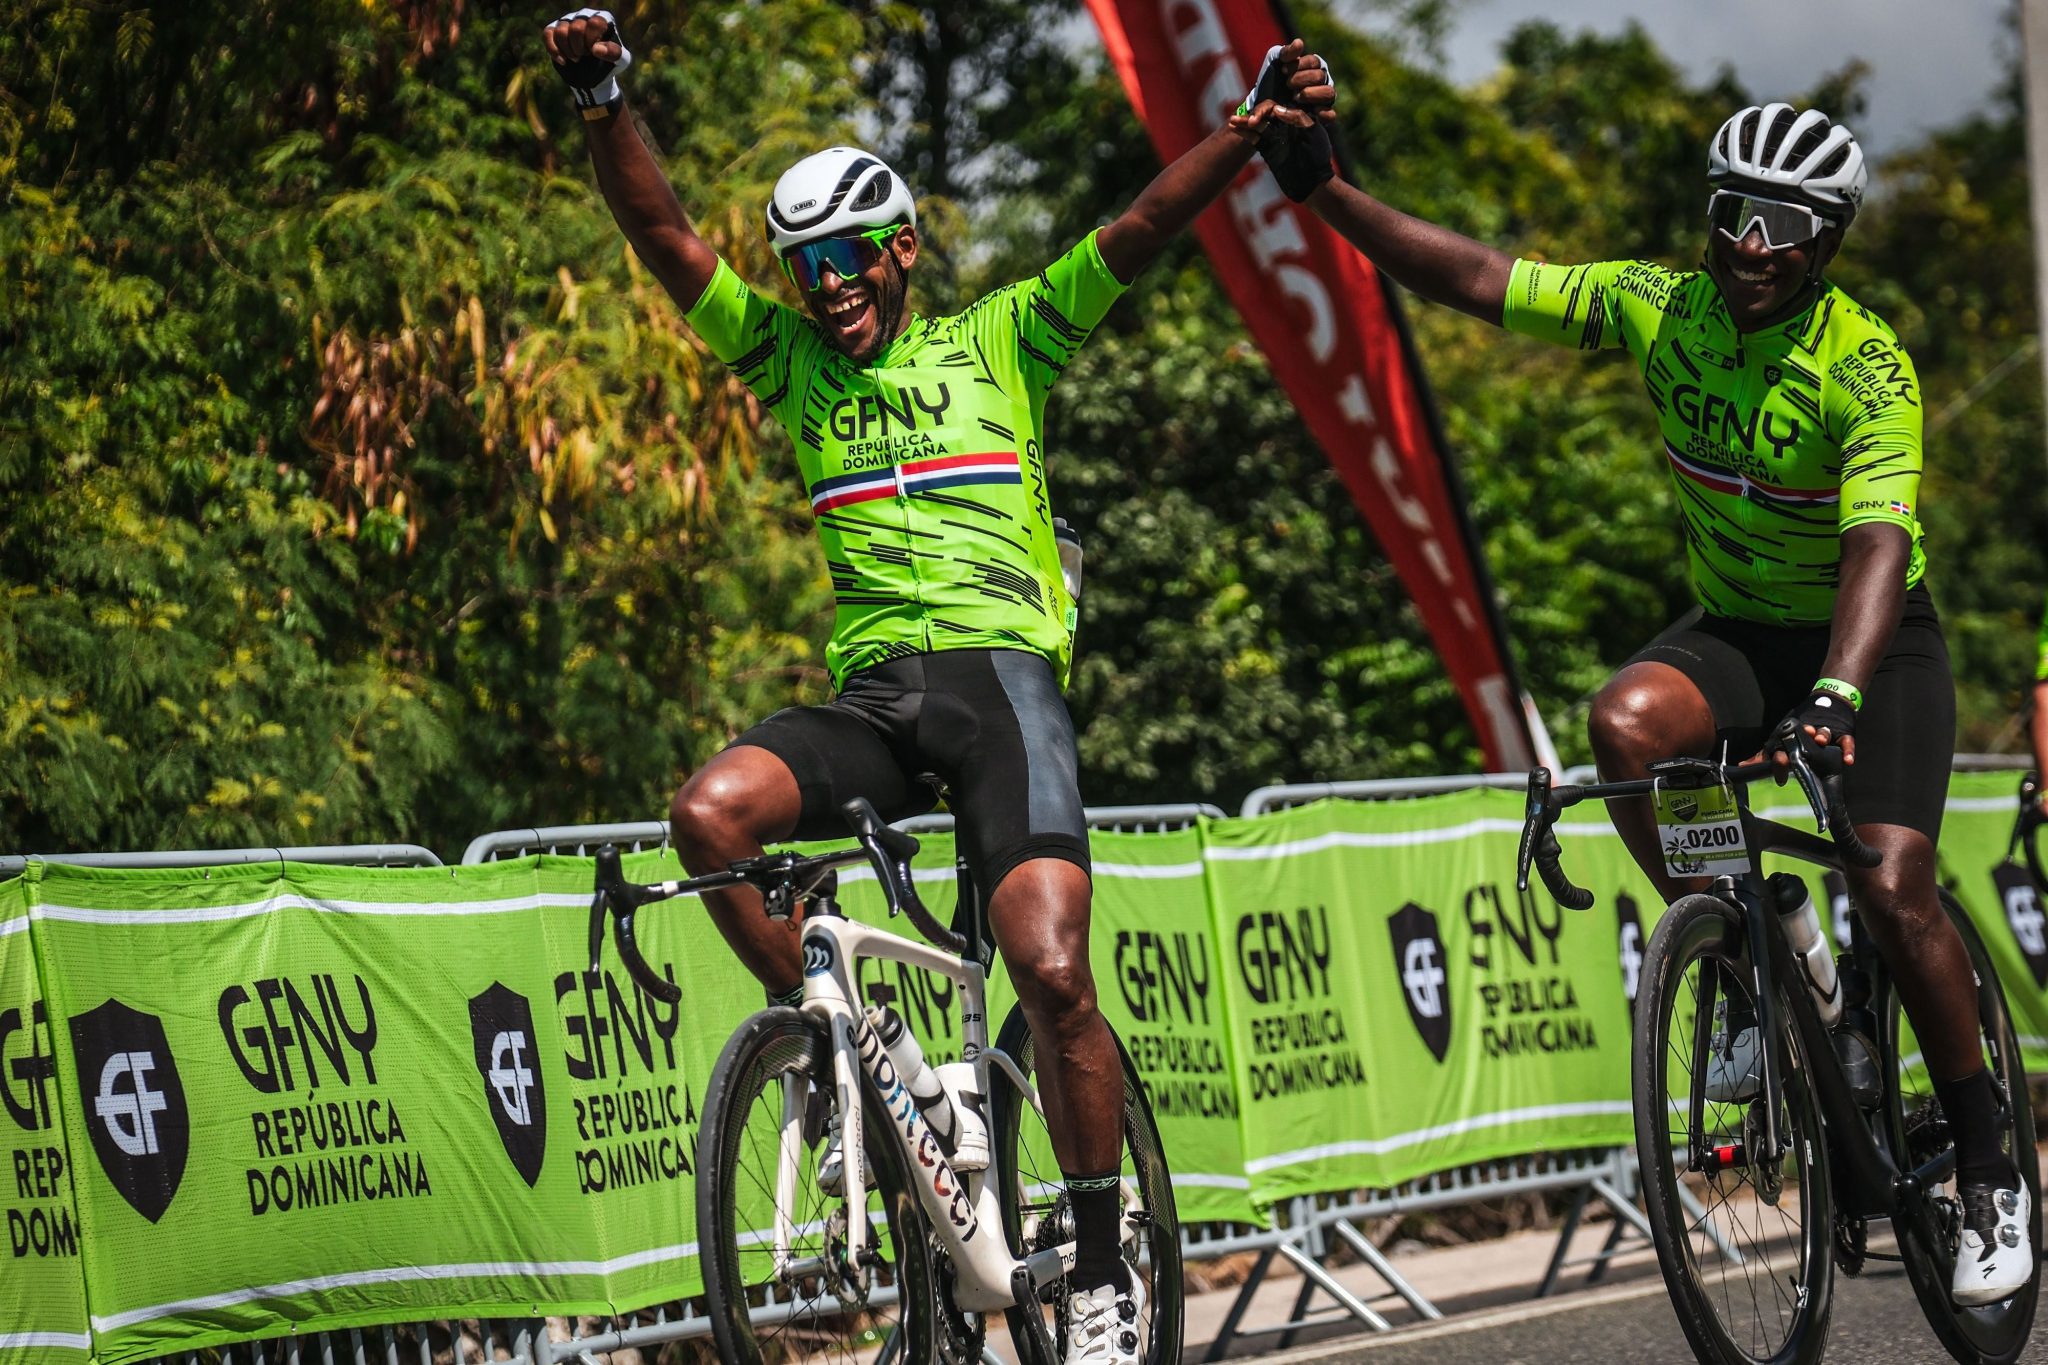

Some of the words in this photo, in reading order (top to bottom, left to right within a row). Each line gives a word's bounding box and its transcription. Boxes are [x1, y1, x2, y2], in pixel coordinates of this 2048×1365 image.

[1858, 338, 1918, 407] GFNY
[829, 381, 951, 442] GFNY
[1671, 383, 1800, 459] GFNY
[843, 442, 949, 471] DOMINICANA
[1026, 438, 1049, 527] GFNY
[1852, 500, 1885, 510] GFNY
[1687, 825, 1739, 848] 0200
[1114, 931, 1210, 1026] GFNY
[1237, 904, 1331, 1004] GFNY
[217, 974, 378, 1094] GFNY
[251, 1089, 407, 1159] REPÚBLICA
[573, 1078, 698, 1142] REPÚBLICA
[246, 1150, 433, 1217] DOMINICANA
